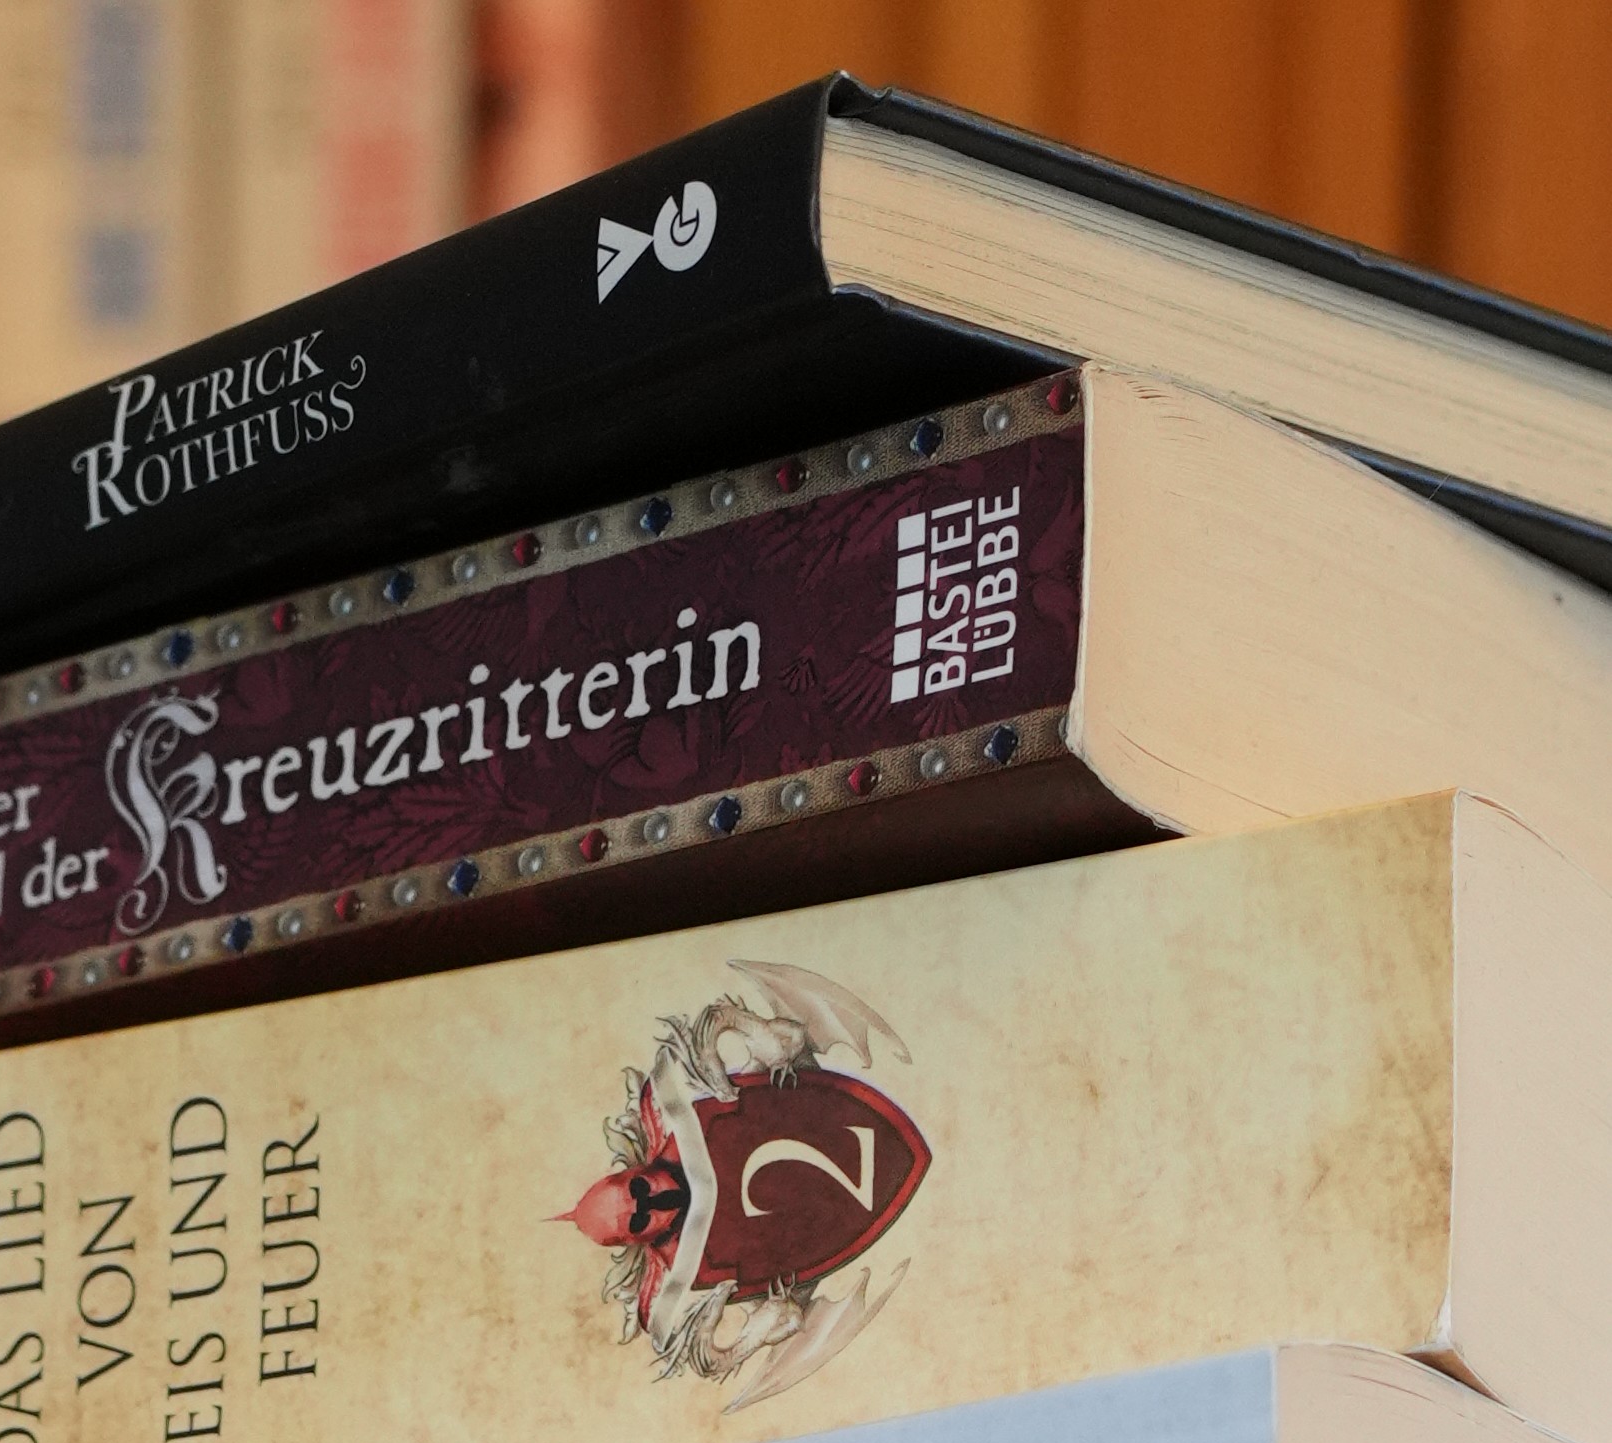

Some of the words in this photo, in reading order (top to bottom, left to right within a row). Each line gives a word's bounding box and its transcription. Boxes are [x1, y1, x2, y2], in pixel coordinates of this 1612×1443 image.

[71, 354, 367, 532] ROTHFUSS
[108, 329, 325, 460] PATRICK
[923, 498, 974, 696] BASTEI
[970, 485, 1021, 684] LÜBBE
[21, 839, 112, 910] der
[105, 606, 764, 937] Kreuzritterin
[169, 1096, 229, 1309] UND
[259, 1113, 321, 1387] FEUER
[741, 1125, 875, 1218] 2
[76, 1194, 137, 1396] VON
